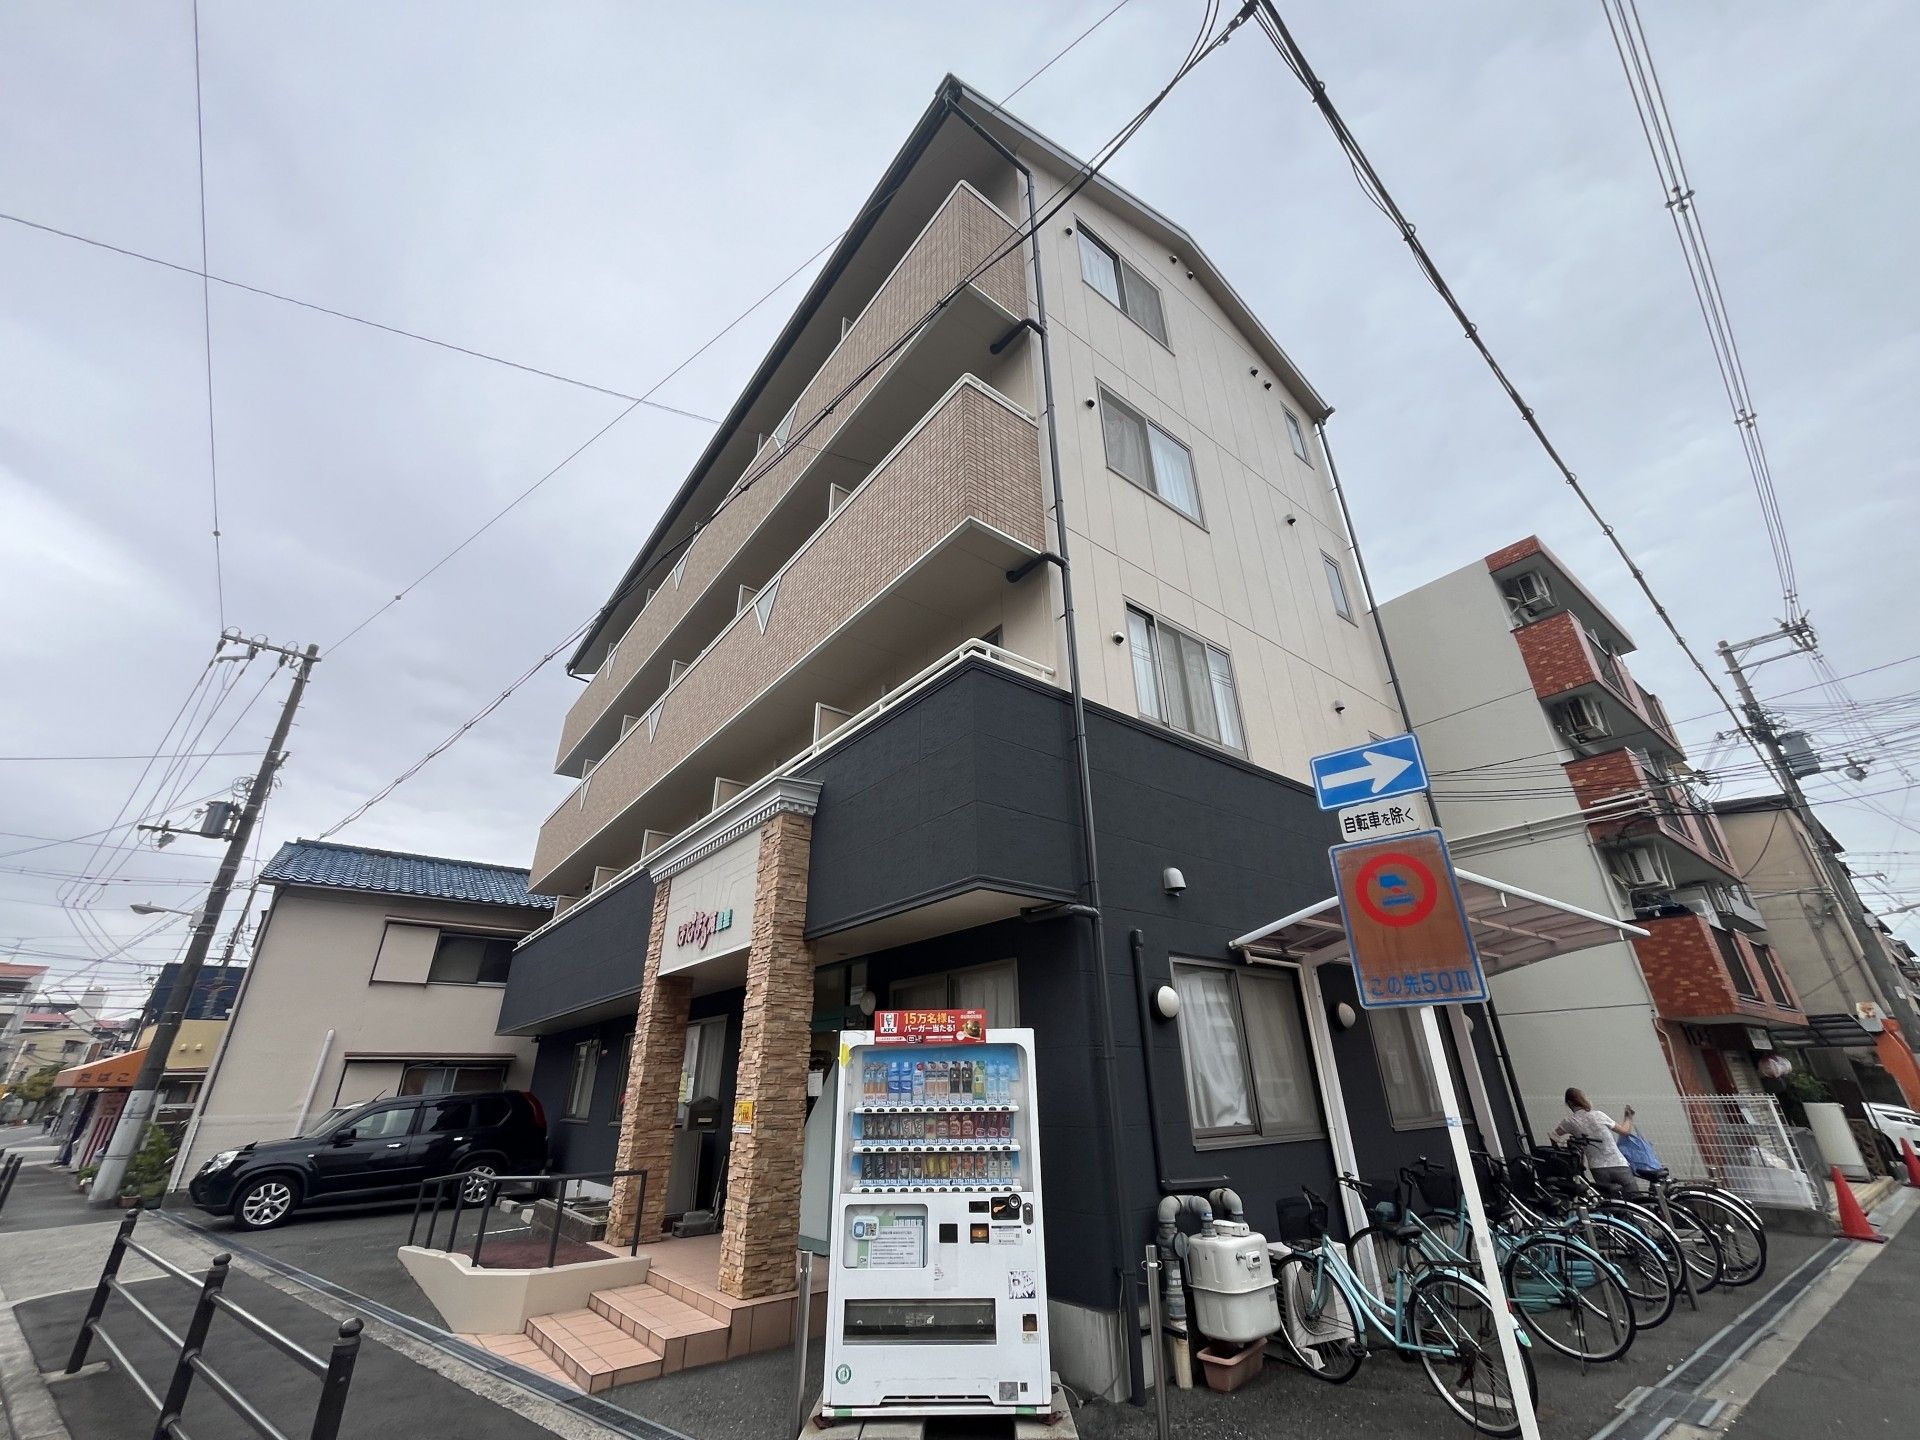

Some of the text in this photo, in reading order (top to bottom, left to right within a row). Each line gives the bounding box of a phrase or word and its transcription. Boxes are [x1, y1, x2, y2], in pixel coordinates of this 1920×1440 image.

[1344, 806, 1414, 833] 自転車を除く
[1370, 970, 1473, 996] この先50m
[904, 1012, 956, 1024] 15万名様に
[904, 1024, 956, 1033] バーガー当たる!
